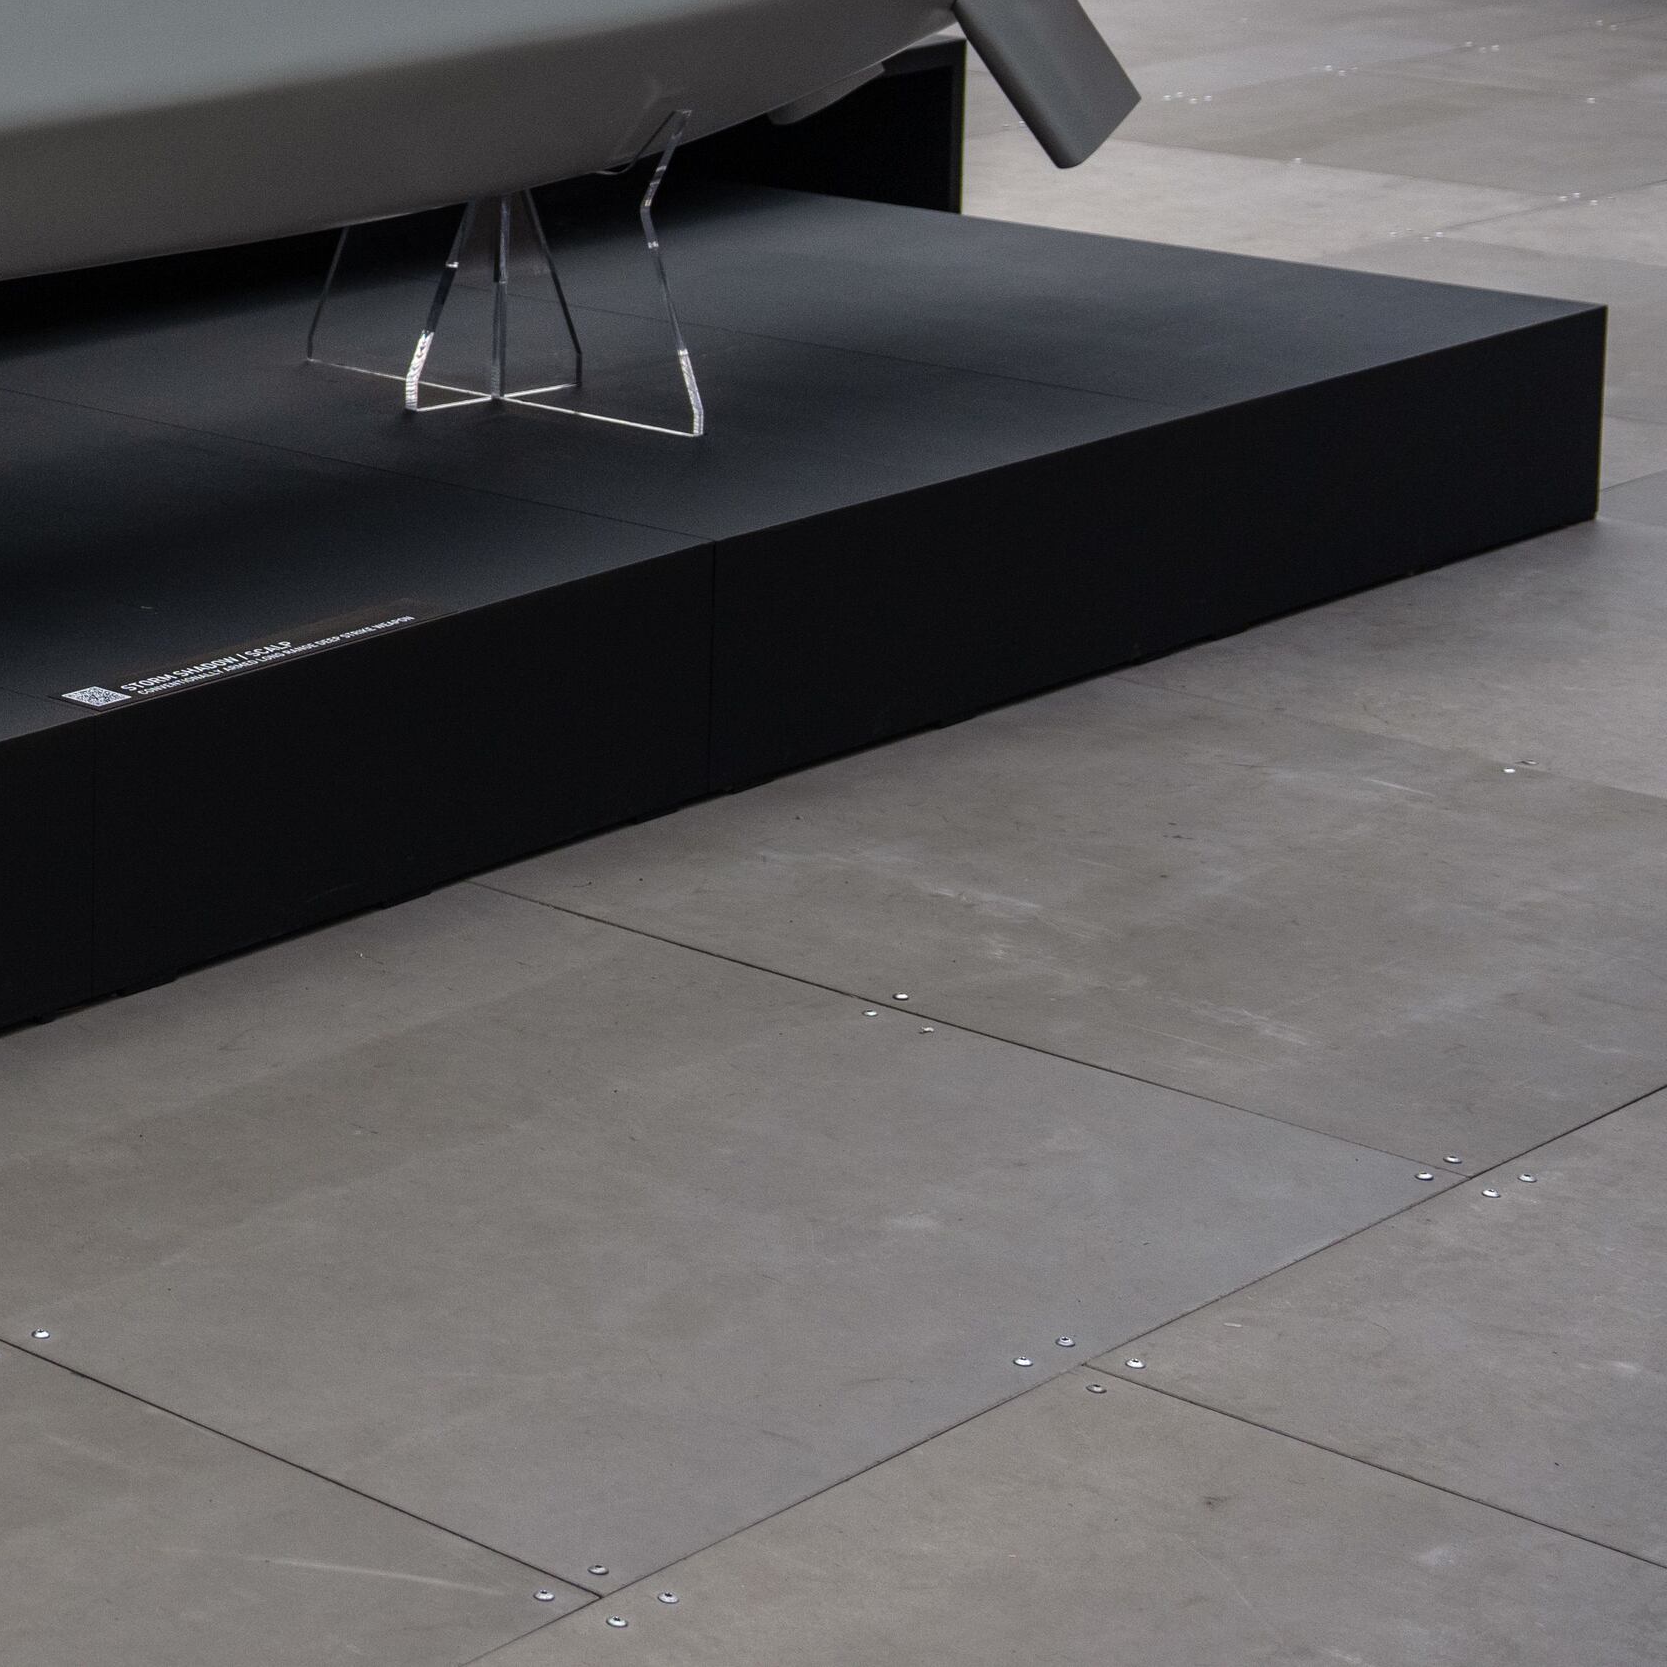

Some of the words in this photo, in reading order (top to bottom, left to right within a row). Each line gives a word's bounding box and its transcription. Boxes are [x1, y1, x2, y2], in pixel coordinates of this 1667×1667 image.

[121, 674, 178, 692] STORM
[173, 656, 239, 677] SHADOW
[244, 641, 291, 657] SCALP
